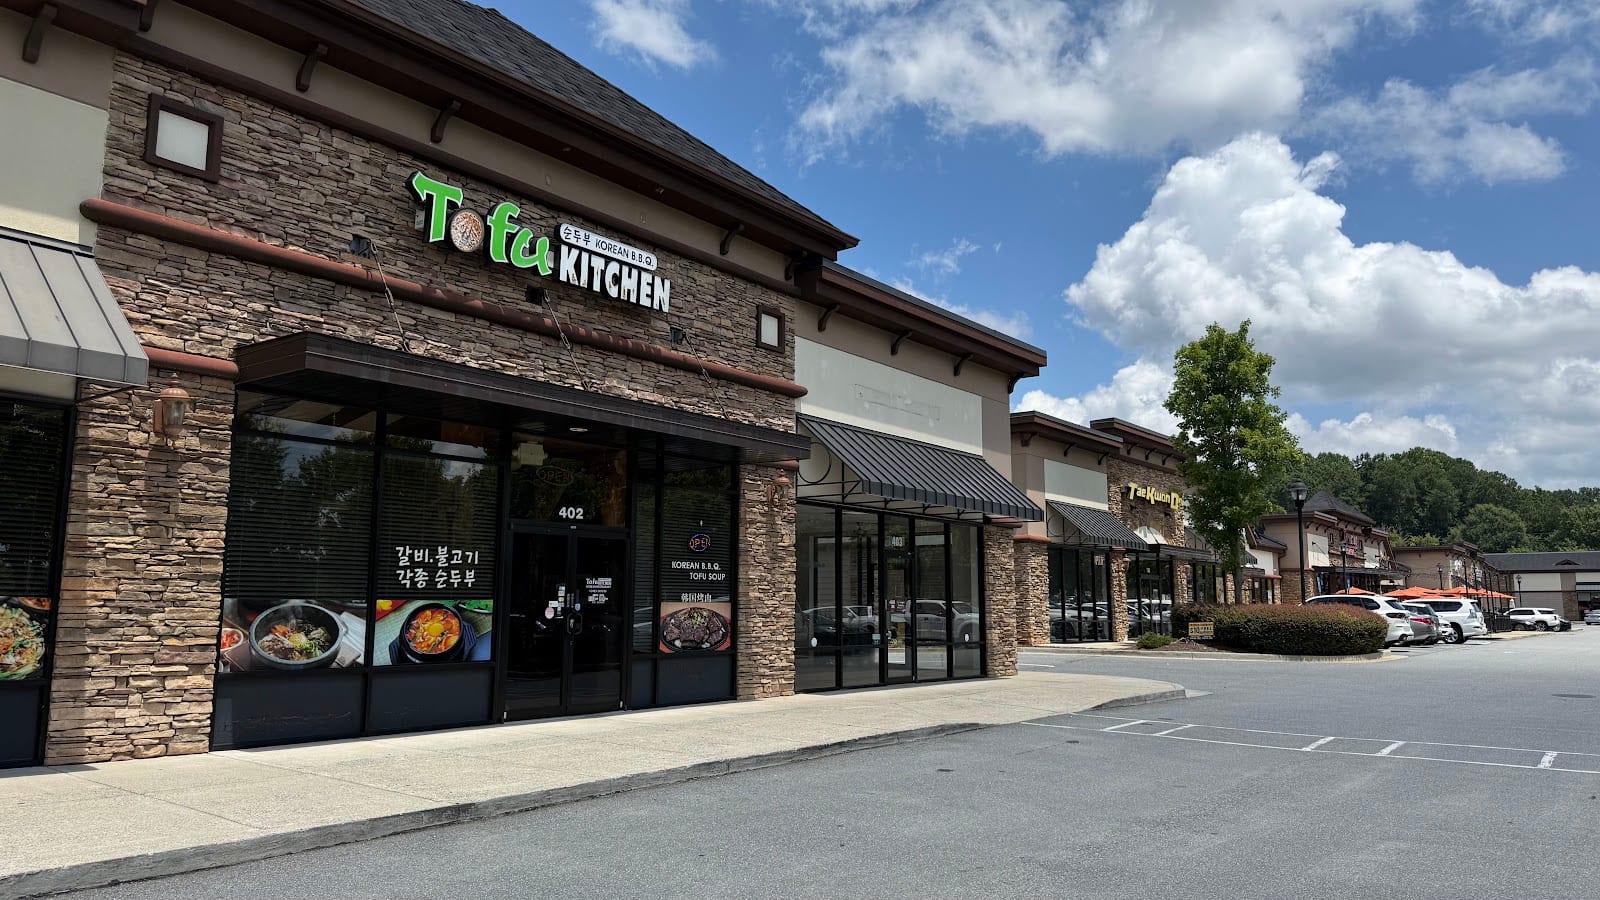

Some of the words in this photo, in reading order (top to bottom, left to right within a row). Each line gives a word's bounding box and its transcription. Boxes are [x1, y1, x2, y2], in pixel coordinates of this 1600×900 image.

[411, 171, 552, 276] Tofu
[563, 226, 592, 246] 순두부
[595, 238, 629, 259] KOREAN
[631, 250, 654, 267] B.B.Q.
[559, 244, 671, 313] KITCHEN
[558, 506, 584, 520] 402
[891, 536, 903, 547] 403
[671, 561, 700, 570] KOREAN
[702, 562, 721, 571] B.B.Q.
[396, 568, 429, 589] 각종
[435, 569, 476, 589] 순두부
[690, 572, 707, 580] TOFU
[708, 573, 726, 581] SOUP
